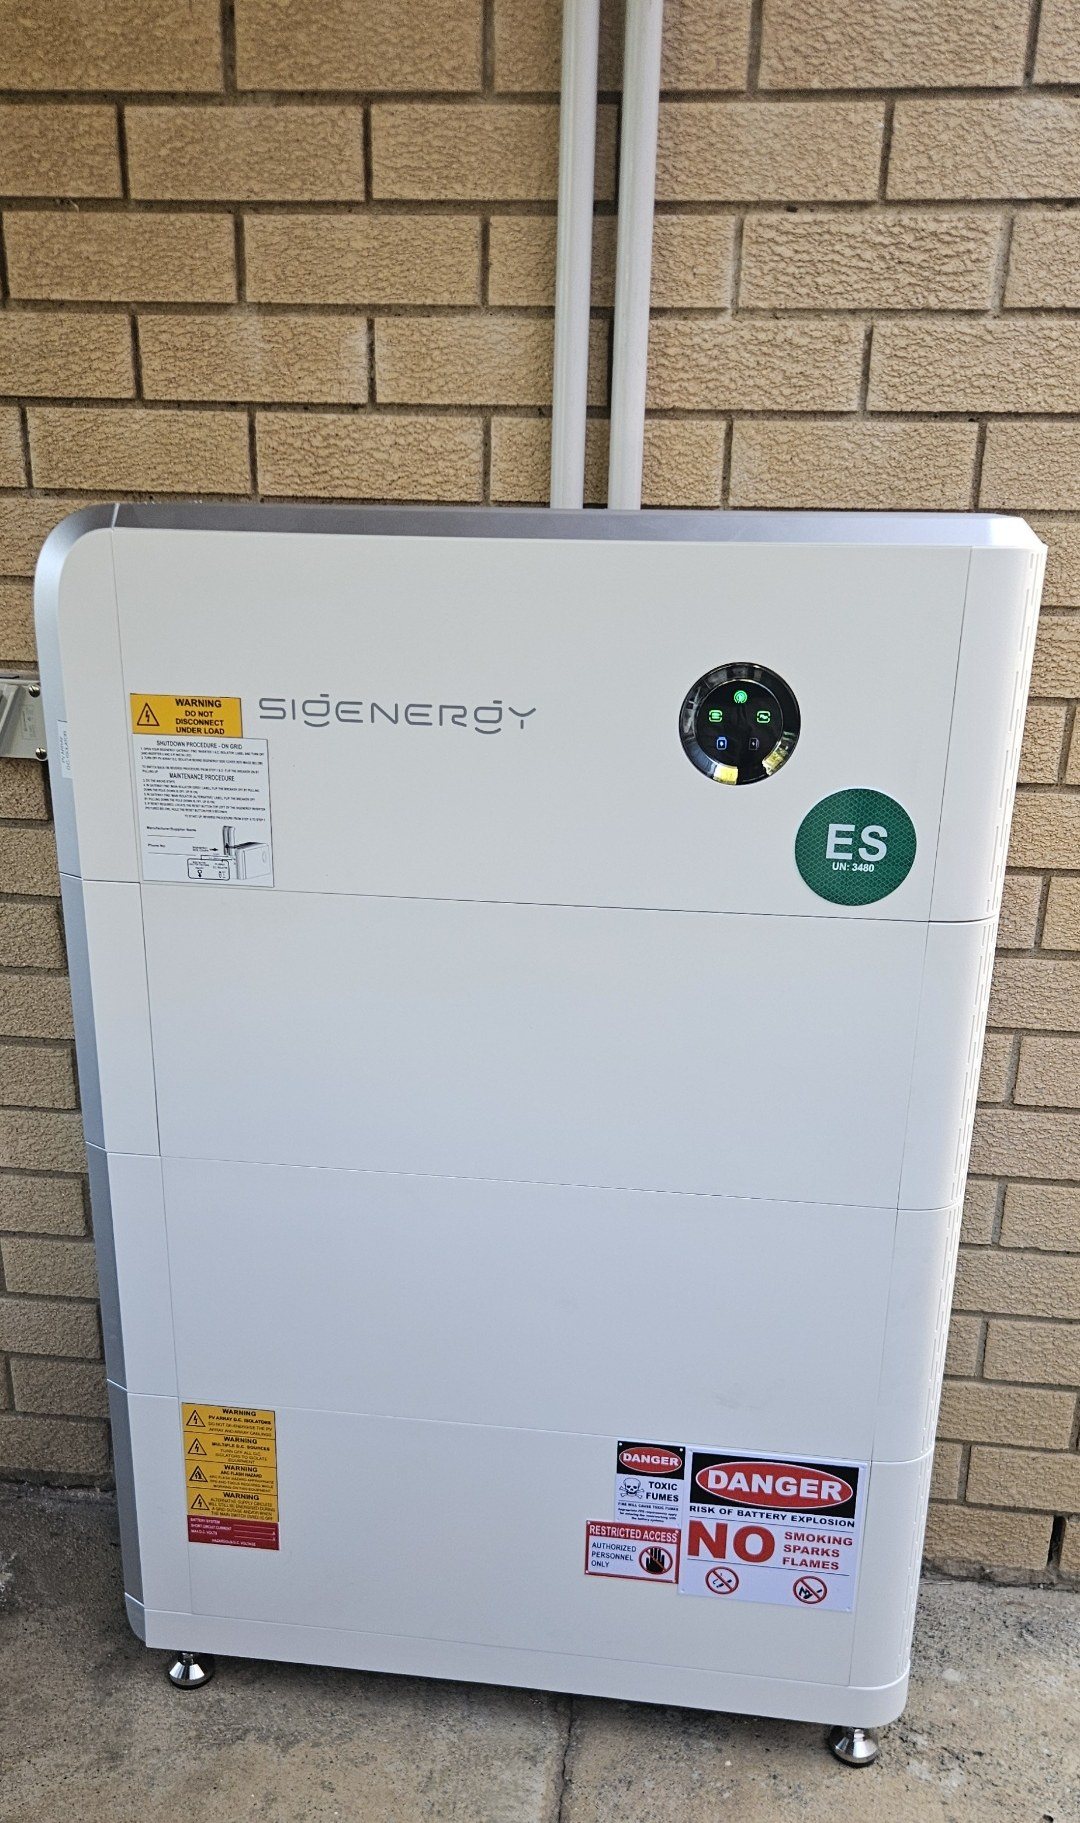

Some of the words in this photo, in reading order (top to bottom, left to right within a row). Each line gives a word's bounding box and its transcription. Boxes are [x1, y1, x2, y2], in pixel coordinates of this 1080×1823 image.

[175, 698, 222, 708] WARNING
[176, 718, 224, 726] DISCONNECT
[826, 823, 888, 862] ES
[832, 862, 850, 871] UN:
[852, 863, 875, 872] 3480
[623, 1452, 678, 1466] DANGER
[648, 1481, 678, 1491] TOXIC
[707, 1469, 842, 1501] DANGER
[223, 1492, 259, 1500] WARNING
[646, 1492, 679, 1502] FUMES
[689, 1505, 715, 1514] RISK
[737, 1510, 787, 1521] BATTERY
[791, 1515, 855, 1528] EXPLOSION
[589, 1524, 641, 1539] RESTRICTED
[643, 1530, 678, 1542] ACCESS
[784, 1531, 853, 1546] SMOKING
[592, 1542, 637, 1553] AUTHORIZED
[688, 1520, 775, 1563] NO
[591, 1551, 634, 1561] PERSONNEL
[784, 1544, 840, 1558] SPARKS
[591, 1560, 610, 1568] ONLY
[782, 1557, 839, 1570] FLAMES
